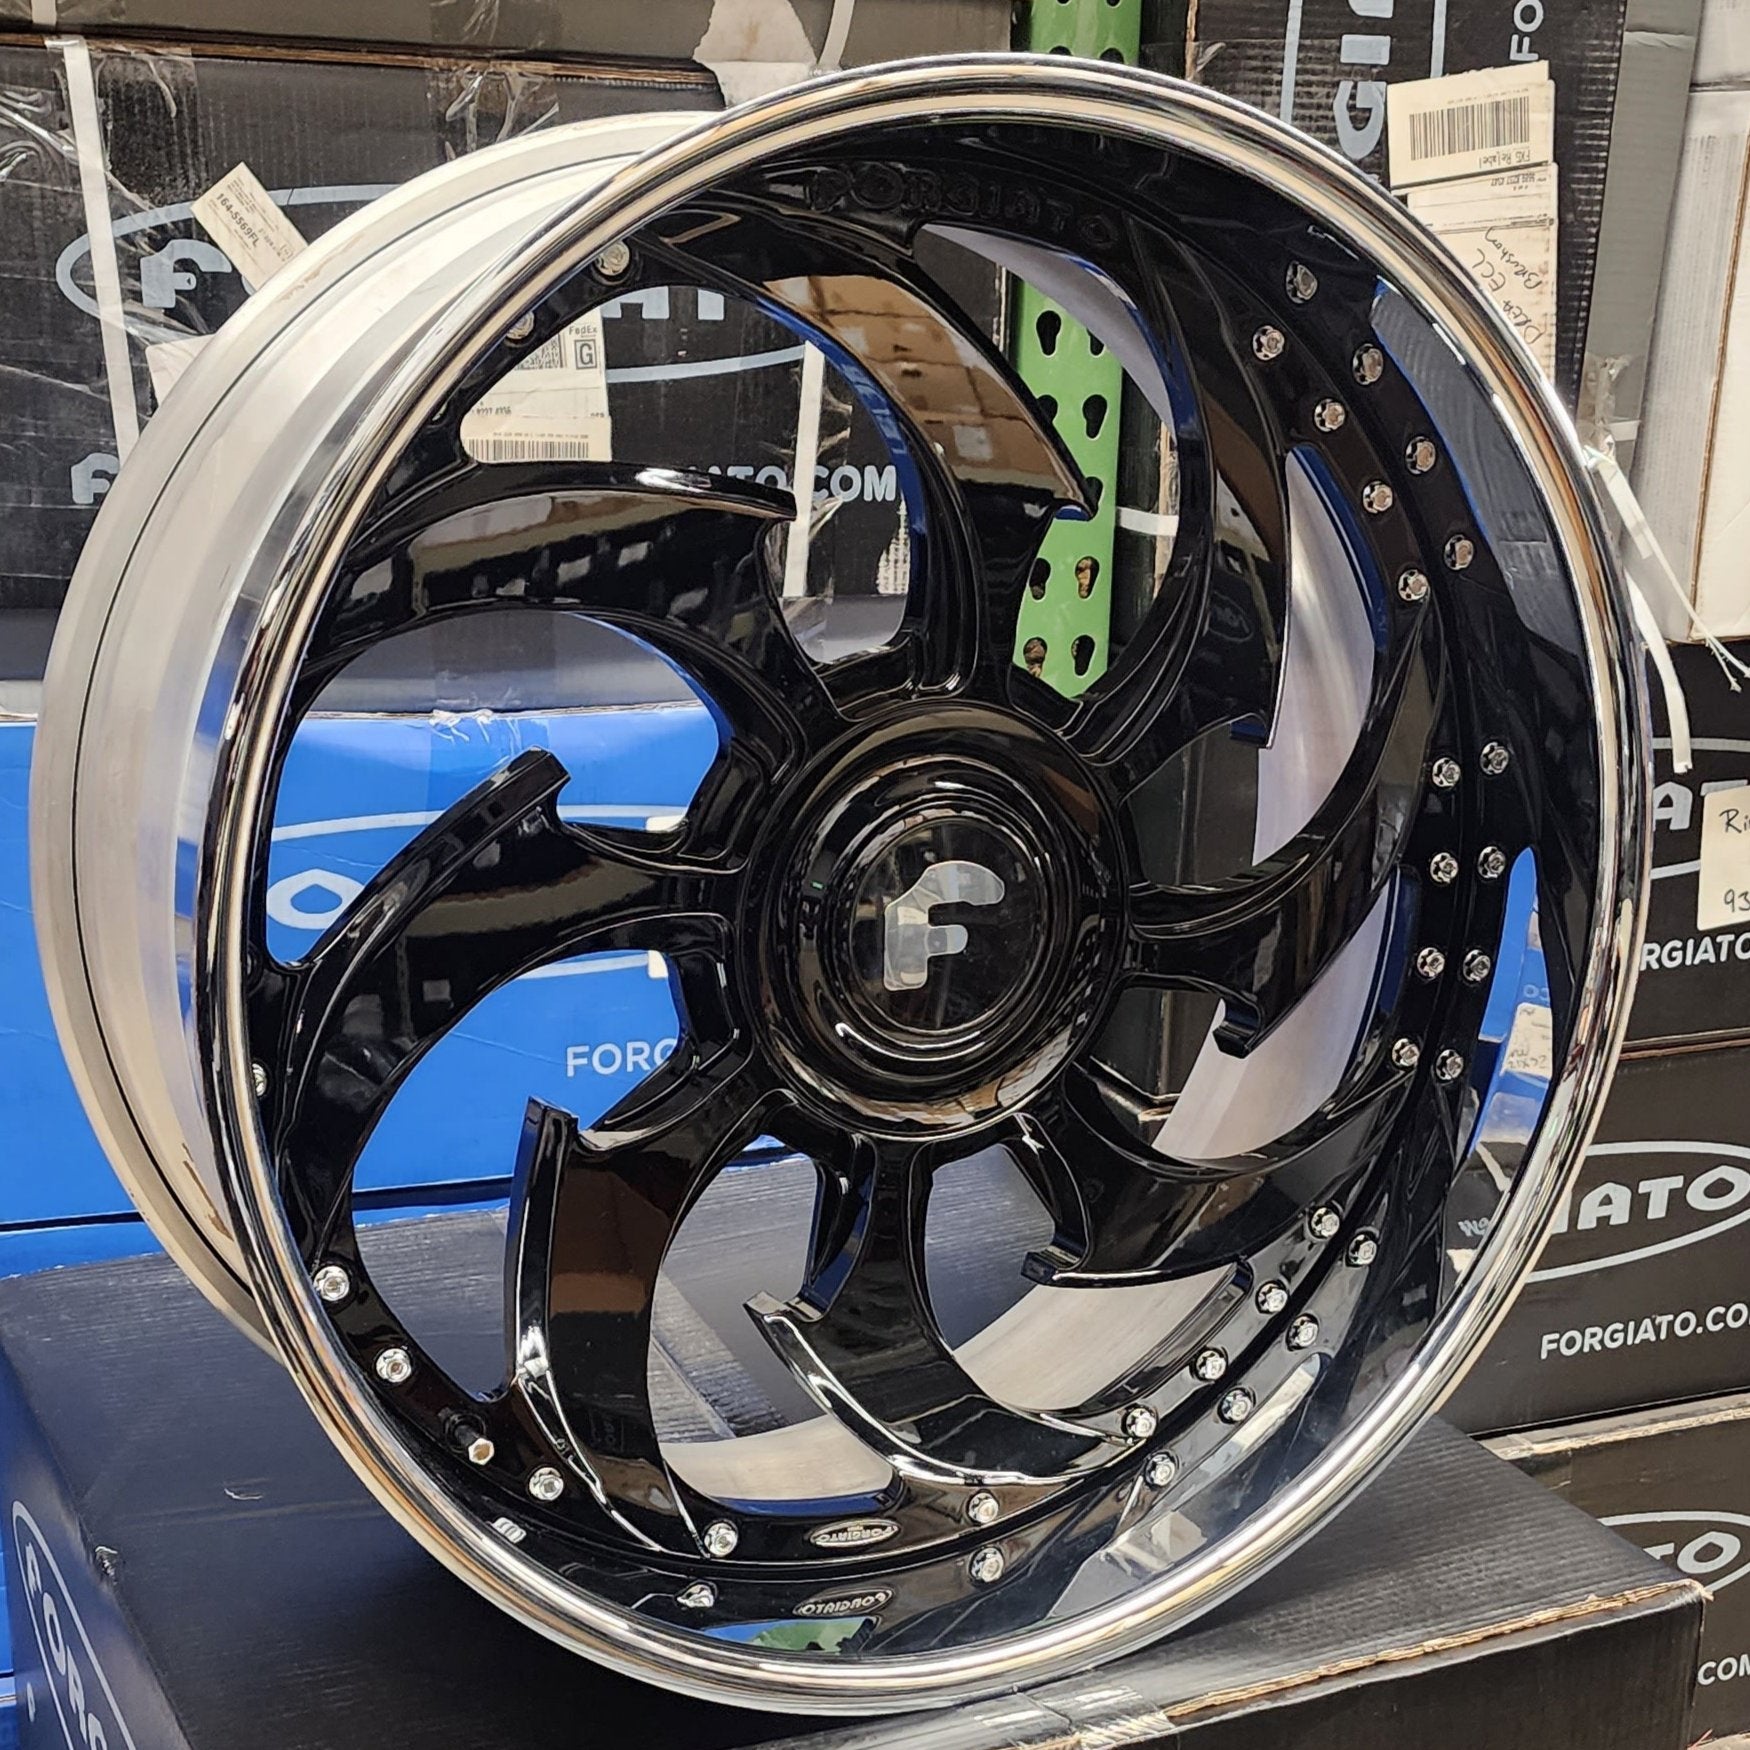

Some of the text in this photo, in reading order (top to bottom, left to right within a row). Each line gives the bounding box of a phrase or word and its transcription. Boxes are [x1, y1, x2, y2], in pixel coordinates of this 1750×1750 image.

[1333, 0, 1394, 160] GI
[580, 342, 595, 366] G
[1540, 1302, 1750, 1360] FORGIATO.CO
